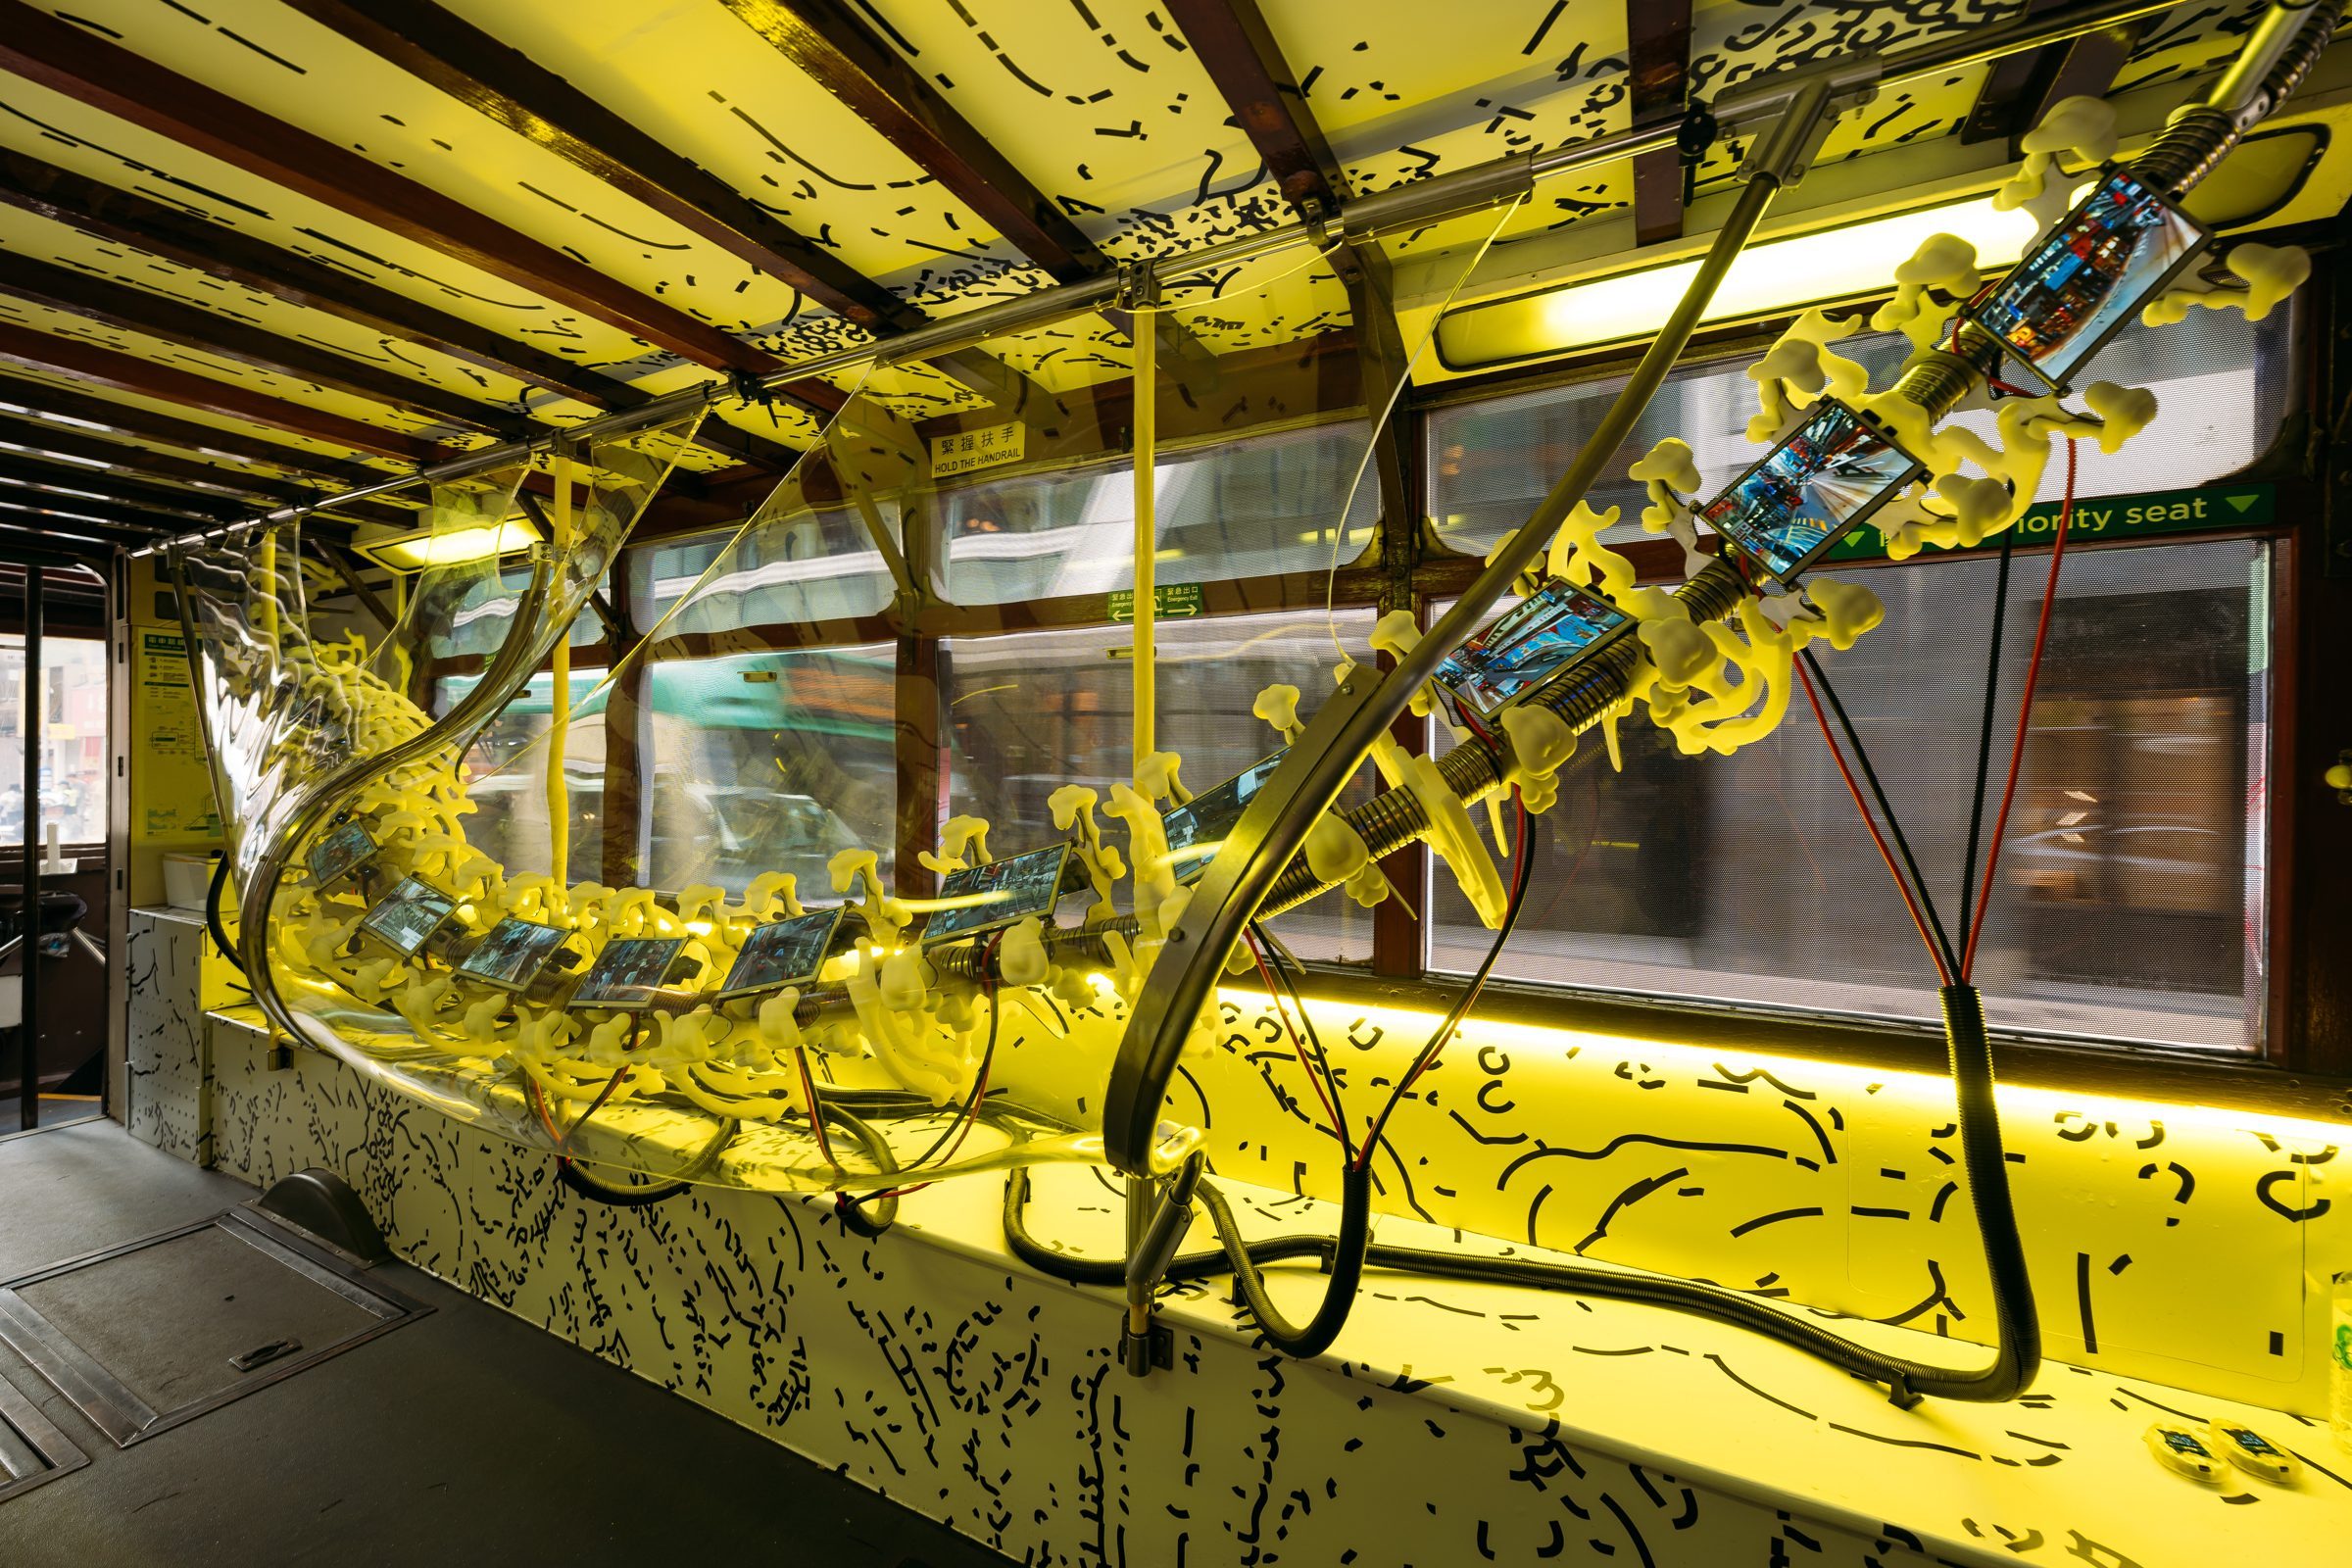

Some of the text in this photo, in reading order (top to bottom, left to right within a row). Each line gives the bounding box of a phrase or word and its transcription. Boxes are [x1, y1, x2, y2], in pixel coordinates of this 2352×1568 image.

[941, 426, 1014, 455] 緊握扶手
[935, 448, 1020, 472] HOLD THE HANDRAIL
[2018, 498, 2207, 534] iority seat
[1112, 592, 1134, 601] 緊急出
